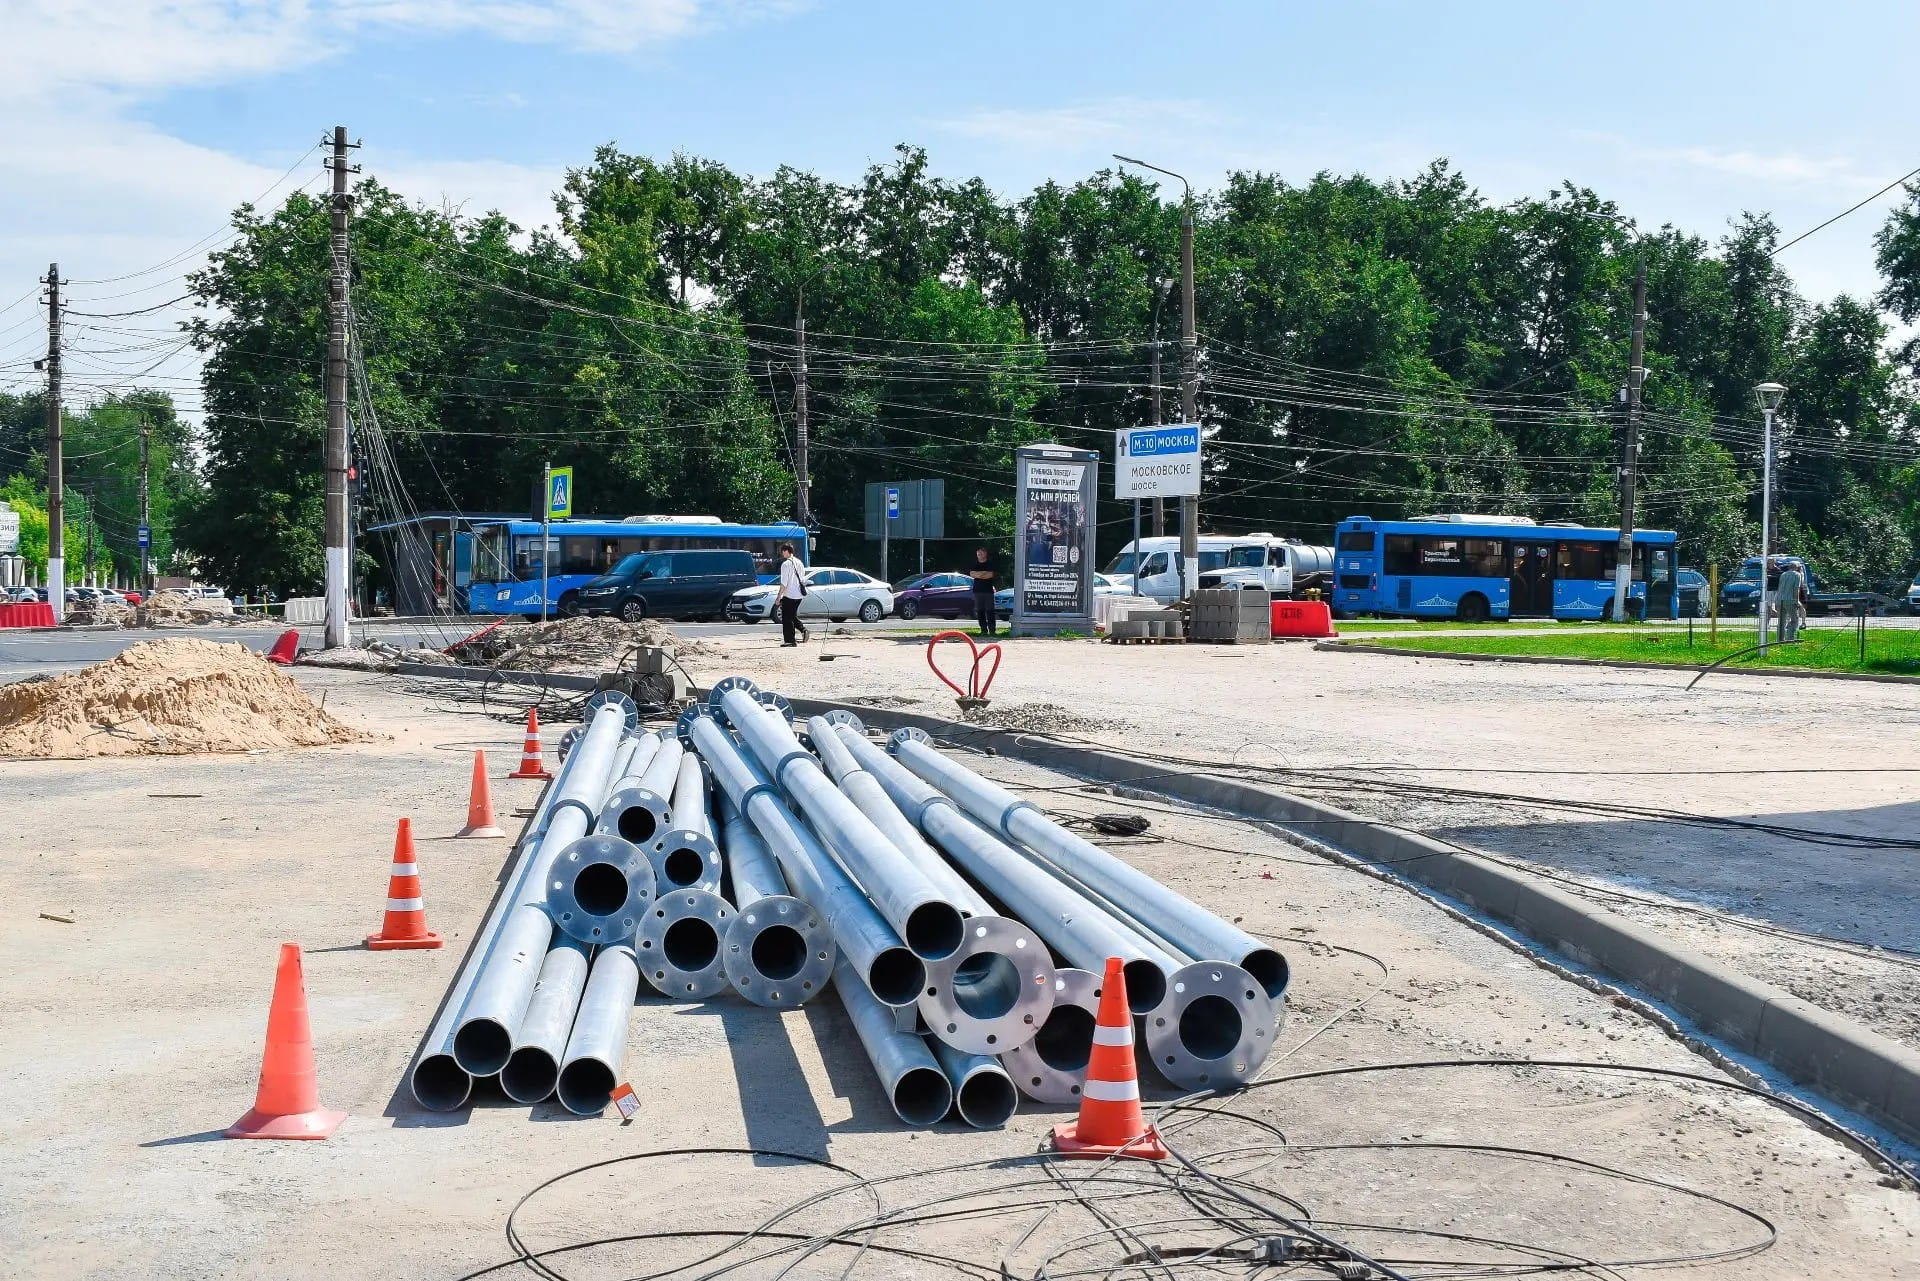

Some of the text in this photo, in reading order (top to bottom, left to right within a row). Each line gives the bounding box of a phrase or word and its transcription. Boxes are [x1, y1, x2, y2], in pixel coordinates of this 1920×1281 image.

[1133, 435, 1196, 450] М-10 МОСКВА
[1131, 463, 1192, 477] МОСКОВСКОЕ
[1131, 481, 1157, 491] шоссе
[1054, 491, 1080, 503] РУБЛЕЙ
